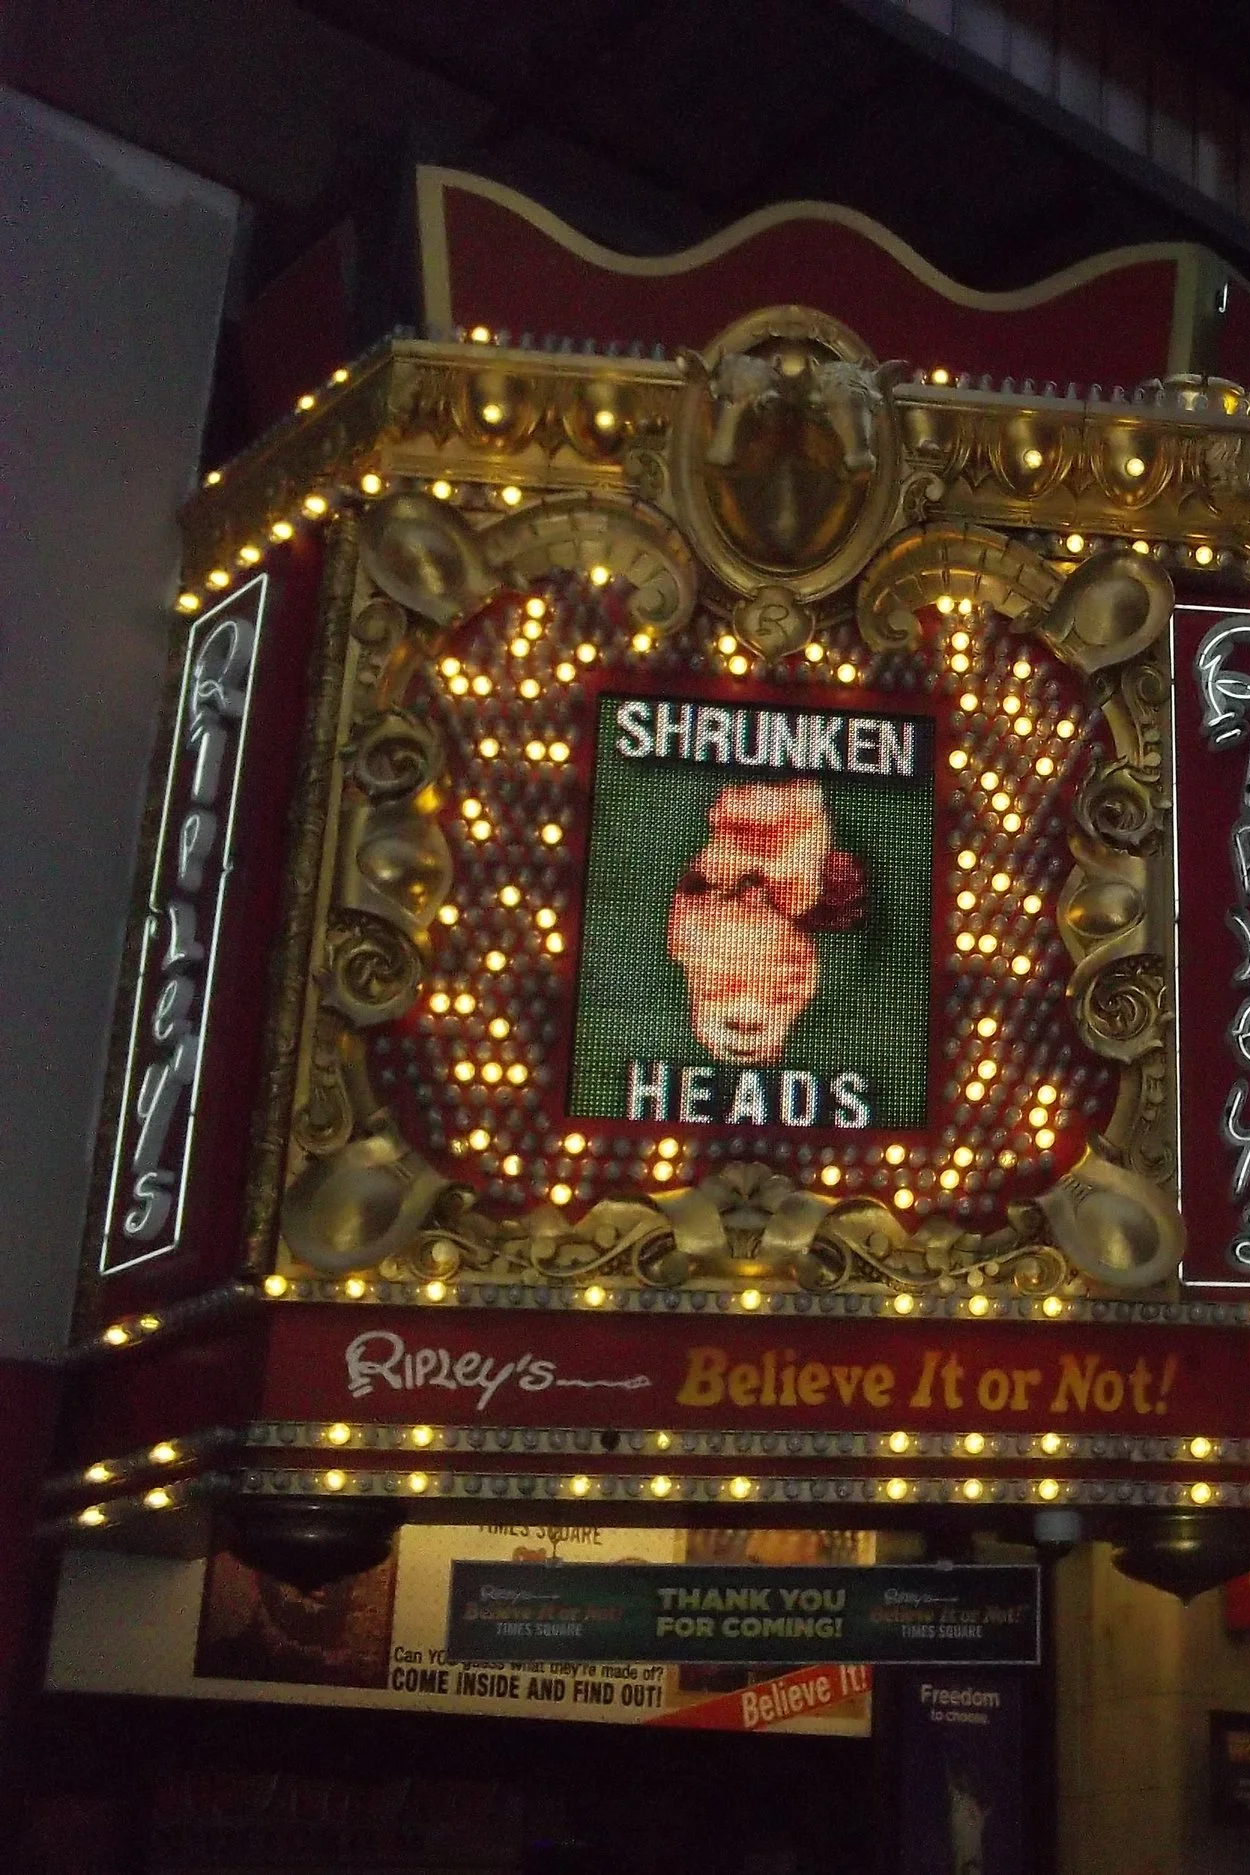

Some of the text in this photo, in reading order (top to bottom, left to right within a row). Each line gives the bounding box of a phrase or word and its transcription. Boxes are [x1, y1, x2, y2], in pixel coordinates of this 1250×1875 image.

[615, 700, 916, 777] SHRUNKEN
[626, 1058, 872, 1130] HEADS
[344, 1330, 1181, 1417] Ripley's Believe It or Not!
[656, 1587, 847, 1612] THANK YOU
[656, 1616, 843, 1639] FOR COMING!
[902, 1624, 984, 1639] TIMES SQUARE
[394, 1646, 422, 1665] Can
[601, 1662, 638, 1680] made
[643, 1664, 665, 1682] of?
[391, 1667, 663, 1709] COME INSIDE AND FIND OUT!
[740, 1663, 868, 1730] Believe It!
[919, 1682, 1001, 1708] Freedom
